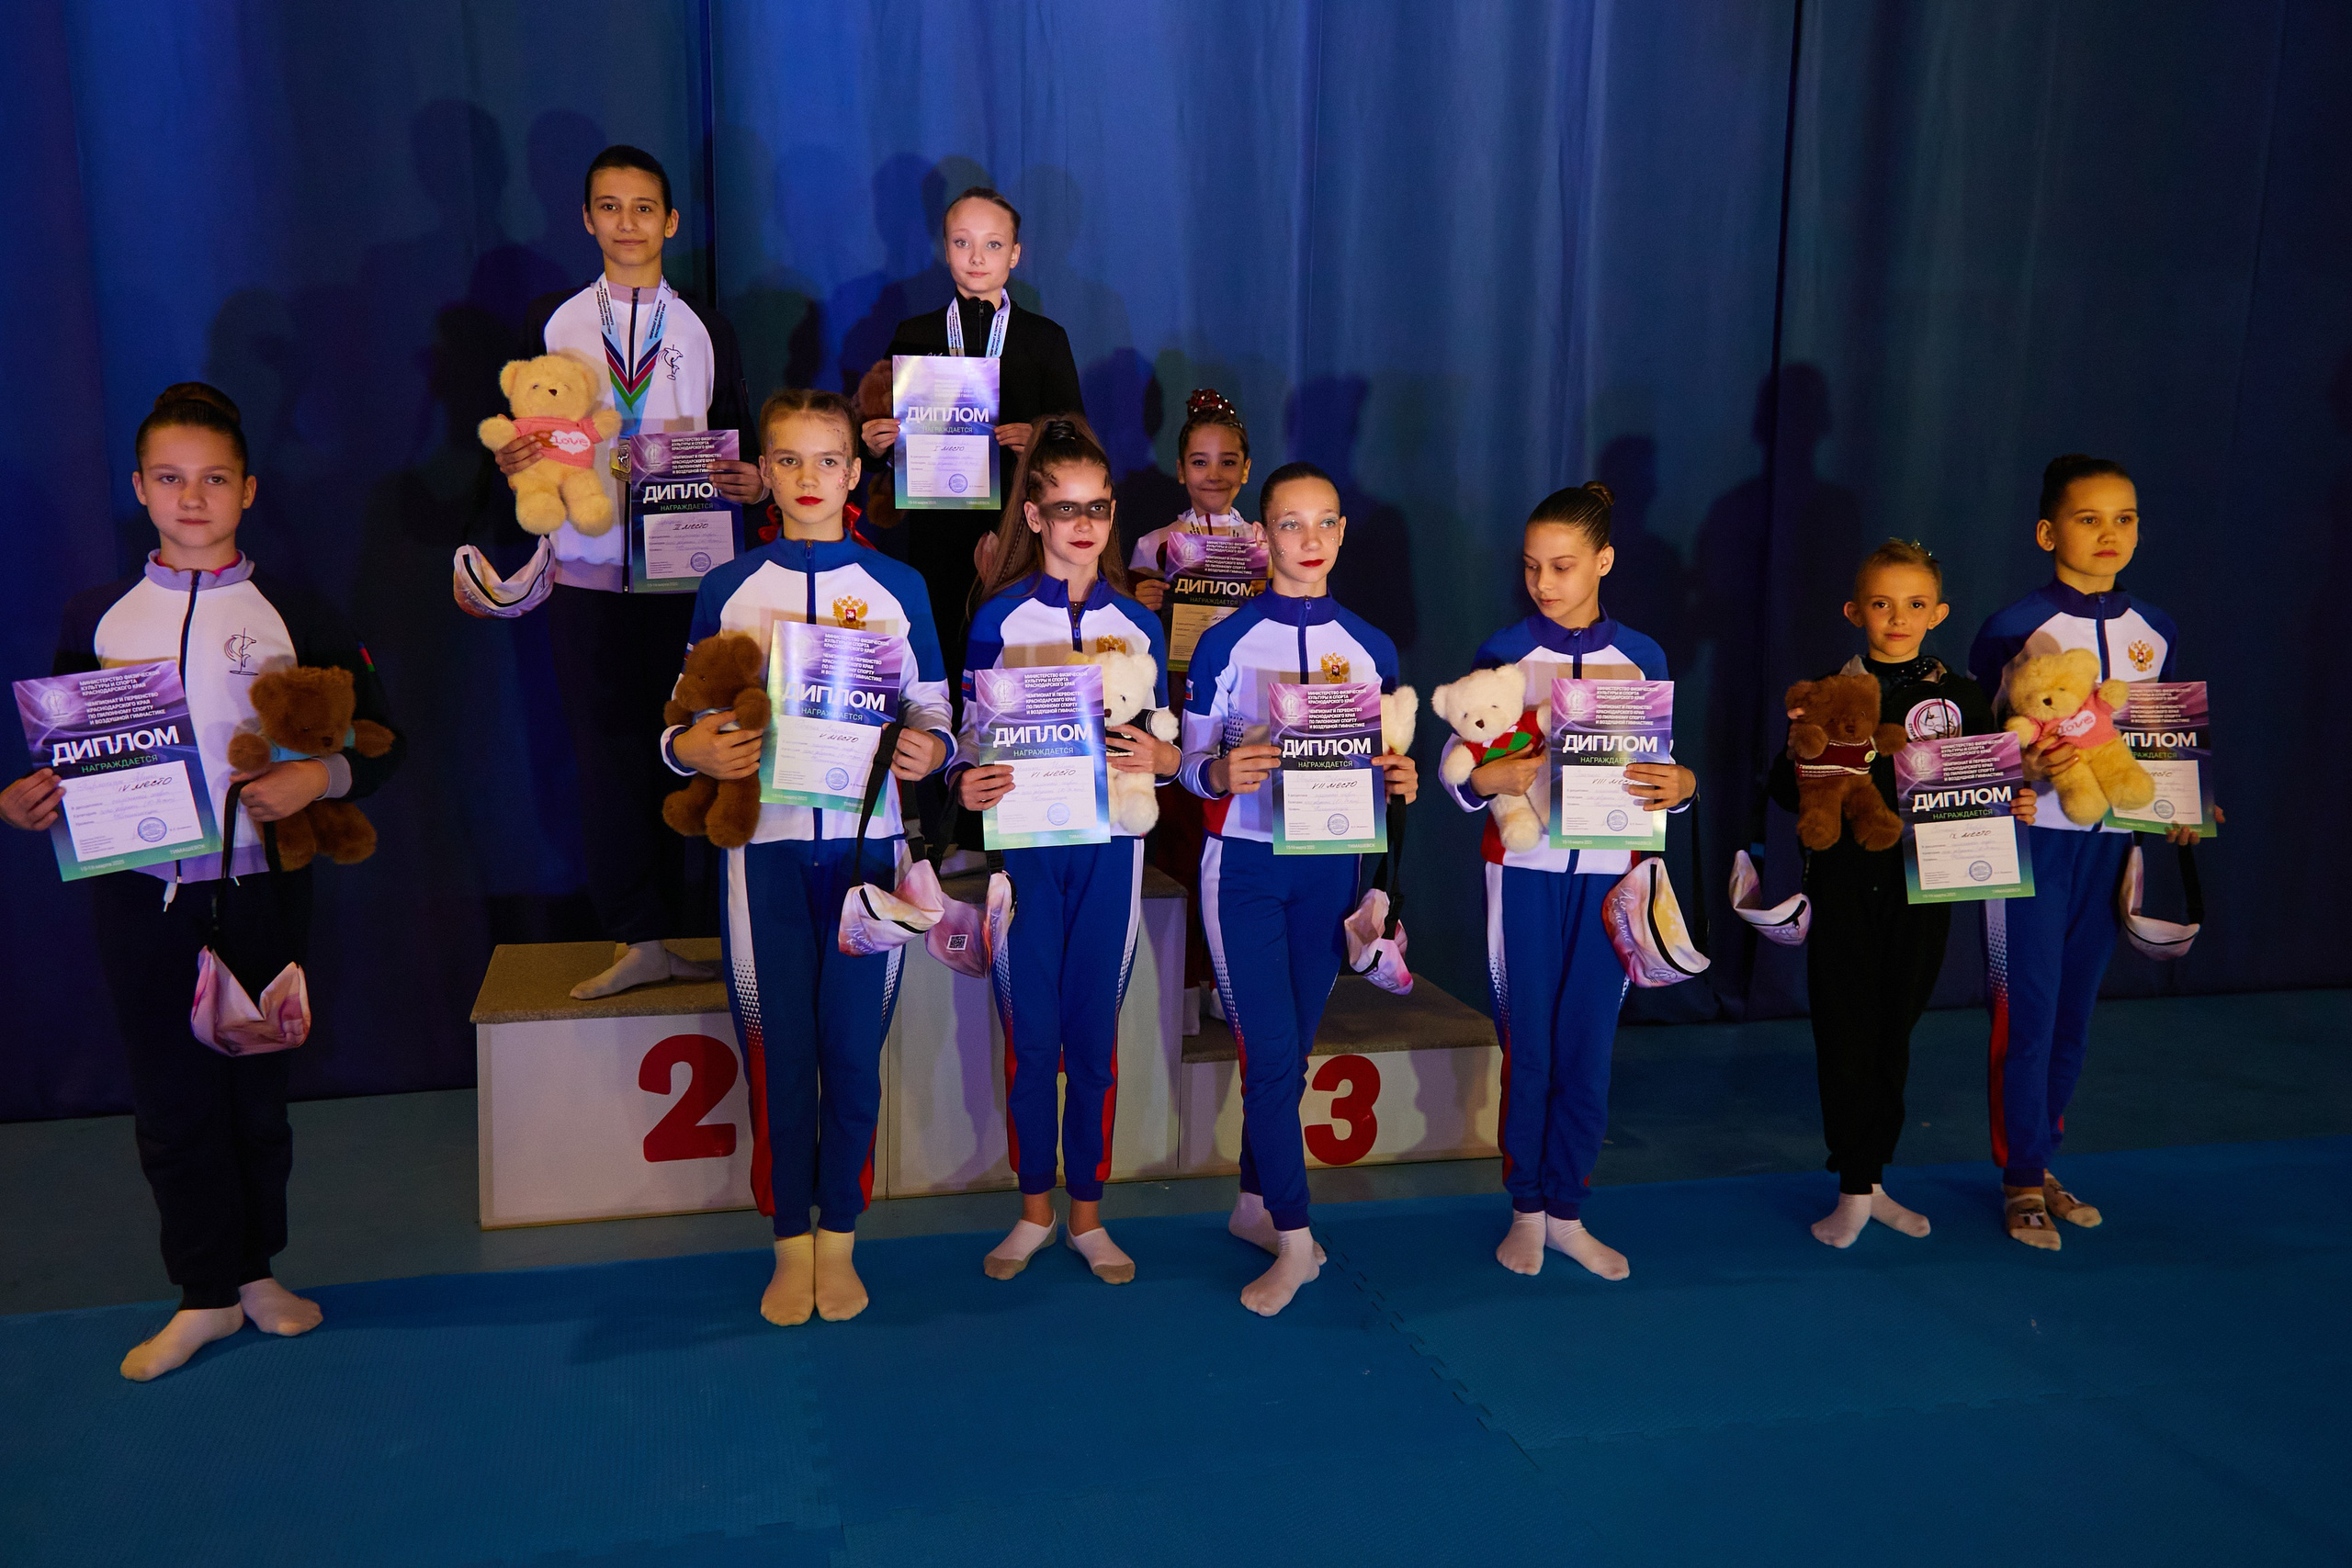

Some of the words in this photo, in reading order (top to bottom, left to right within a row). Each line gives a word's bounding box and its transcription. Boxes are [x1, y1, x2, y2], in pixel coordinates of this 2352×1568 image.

[905, 407, 989, 423] ДИПЛОМ
[1175, 578, 1255, 596] ДИПЛОМ
[781, 682, 885, 711] ДИПЛОМ
[52, 725, 179, 766] ДИПЛОМ
[993, 724, 1093, 748] ДИПЛОМ
[1563, 735, 1657, 753] ДИПЛОМ
[2122, 732, 2197, 747] ИПЛОМ
[1014, 748, 1073, 757] НАГРАЖДАЕТСЯ
[1283, 738, 1371, 758] ДИПЛОМ
[81, 755, 158, 773] НАГРАЖДАЕТСЯ
[1912, 786, 2011, 812] ДИПЛОМ
[1933, 809, 1993, 819] НАГРАЖДАЕТСЯ
[638, 1034, 738, 1162] 2
[1304, 1054, 1381, 1165] 3
